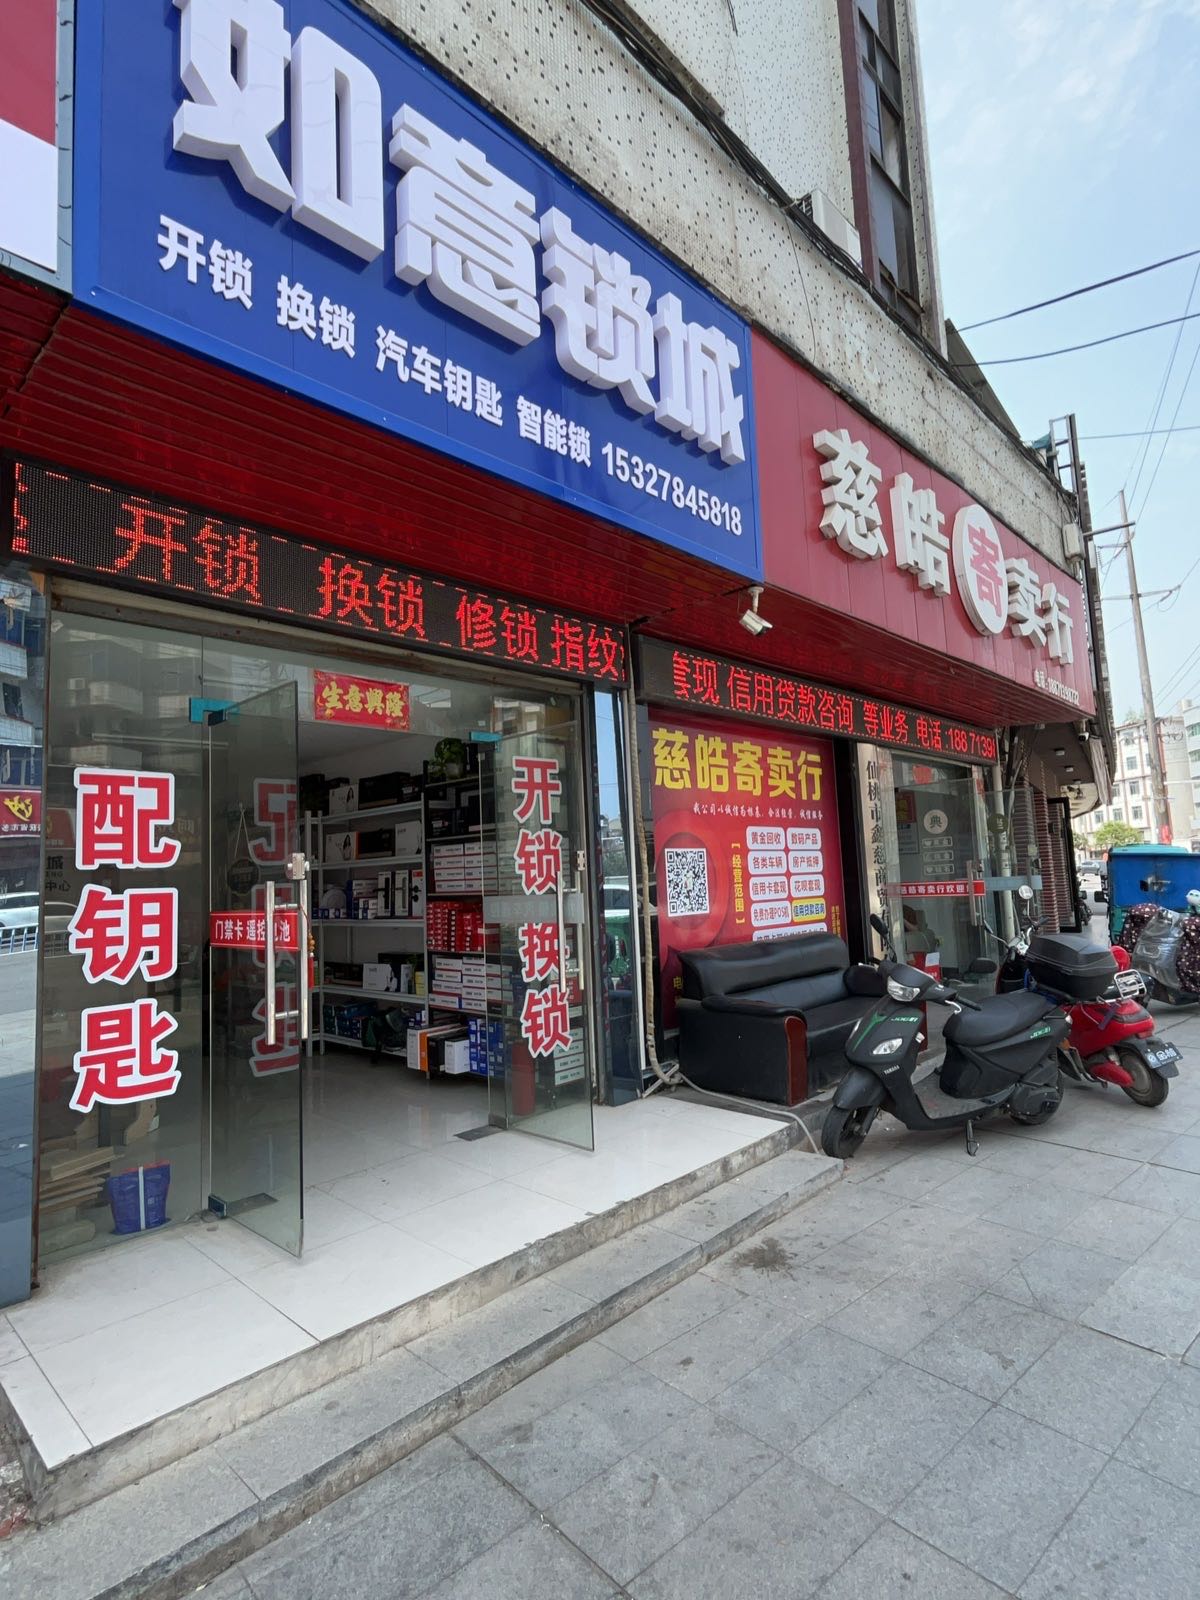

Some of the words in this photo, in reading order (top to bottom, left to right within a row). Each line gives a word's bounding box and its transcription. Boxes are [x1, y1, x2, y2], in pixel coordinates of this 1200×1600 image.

[172, 0, 745, 466] 如意锁城
[157, 214, 253, 310] 开锁
[276, 274, 356, 359] 换锁
[375, 325, 503, 427] 汽车钥匙
[516, 395, 592, 468] 智能锁
[601, 442, 742, 536] 15327845818
[813, 428, 1074, 664] 慈皓寄卖行
[114, 503, 261, 600] 开锁
[317, 557, 426, 637] 换锁
[455, 595, 539, 662] 修锁
[551, 619, 625, 682] 指纹
[726, 665, 854, 732] 信用贷款咨询
[863, 701, 909, 742] 等业务
[652, 728, 823, 800] 慈皓寄卖行
[751, 832, 782, 845] 黄金回收
[752, 855, 783, 869] 各类车辆
[791, 832, 819, 845] 数码产品
[792, 855, 819, 868] 房产抵押
[752, 881, 787, 895] 信用卡套现
[69, 767, 181, 1113] 配钥匙
[215, 919, 244, 941] 门禁卡
